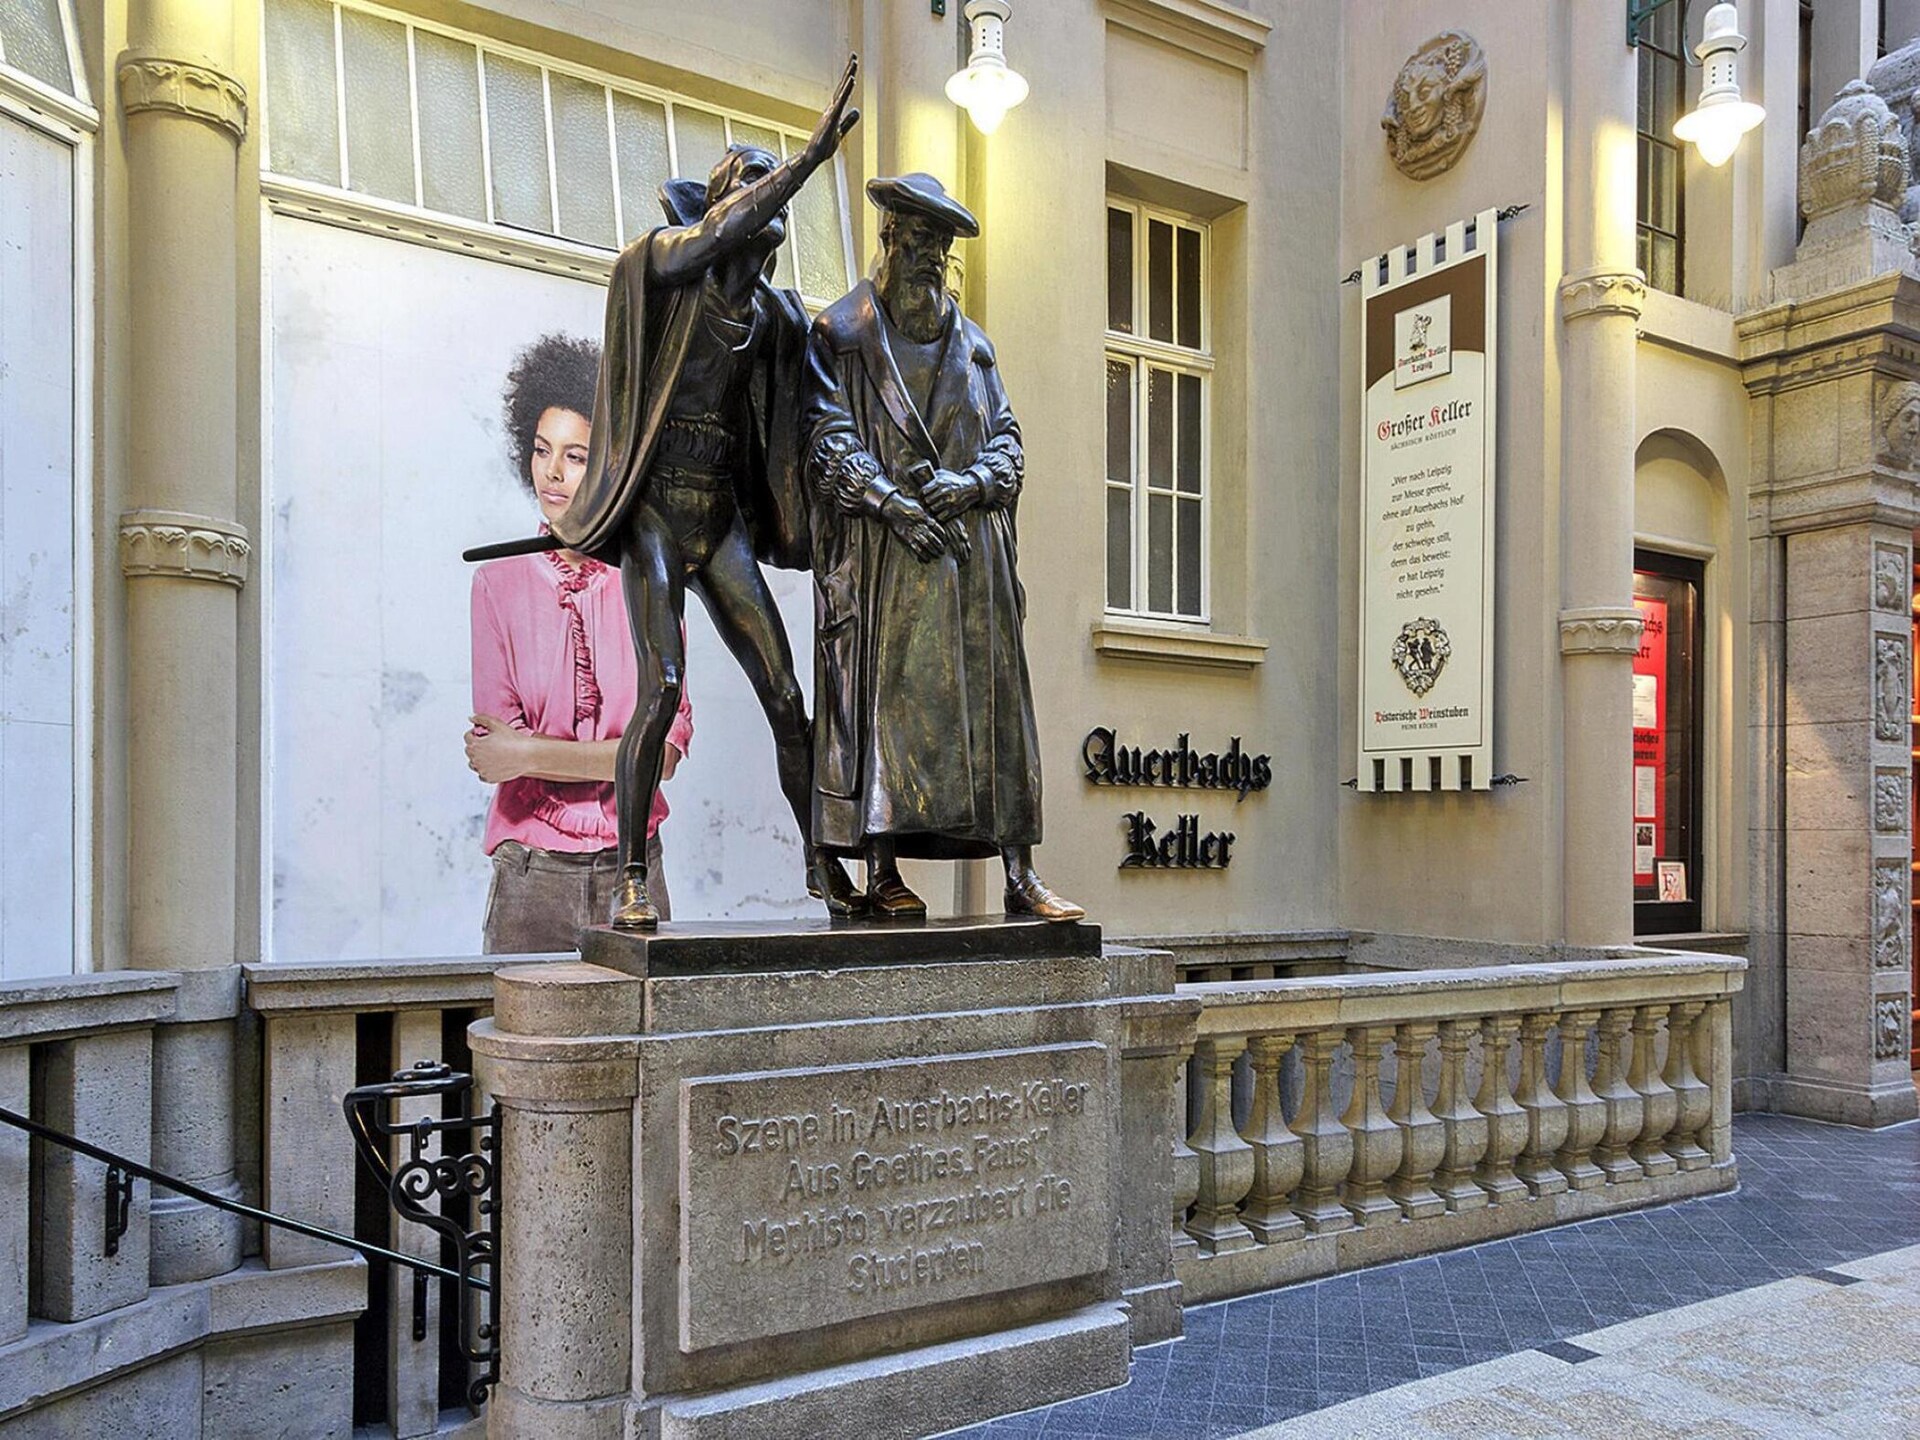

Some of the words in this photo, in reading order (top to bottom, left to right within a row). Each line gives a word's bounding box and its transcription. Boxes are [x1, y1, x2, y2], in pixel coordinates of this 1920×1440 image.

[1377, 414, 1425, 441] Großer
[1428, 400, 1472, 427] Keller
[1409, 470, 1425, 481] nach
[1427, 465, 1452, 478] Leipzig
[1392, 494, 1403, 503] zur
[1404, 489, 1424, 499] Messe
[1382, 511, 1399, 521] ohne
[1400, 505, 1412, 517] auf
[1413, 499, 1448, 514] Auerbachs
[1450, 494, 1464, 506] Hof
[1406, 523, 1415, 533] zu
[1392, 542, 1403, 551] der
[1405, 537, 1435, 549] schweige
[1390, 559, 1408, 568] denn
[1409, 555, 1421, 565] das
[1398, 575, 1406, 583] er
[1406, 572, 1418, 581] hat
[1419, 568, 1445, 580] Leipzig
[1396, 589, 1414, 599] nicht
[1375, 709, 1417, 724] Historische
[1419, 706, 1469, 720] Weinstuben
[1082, 726, 1272, 802] Auerbachs
[1117, 810, 1236, 869] Keller
[716, 1113, 819, 1155] Szene
[831, 1102, 856, 1142] in
[781, 1159, 841, 1201] Aus
[851, 1143, 963, 1191] Goethes
[740, 1204, 868, 1266] Mephisto
[877, 1178, 1026, 1238] verzaubert
[1035, 1173, 1072, 1214] die
[847, 1238, 986, 1294] Studenten
